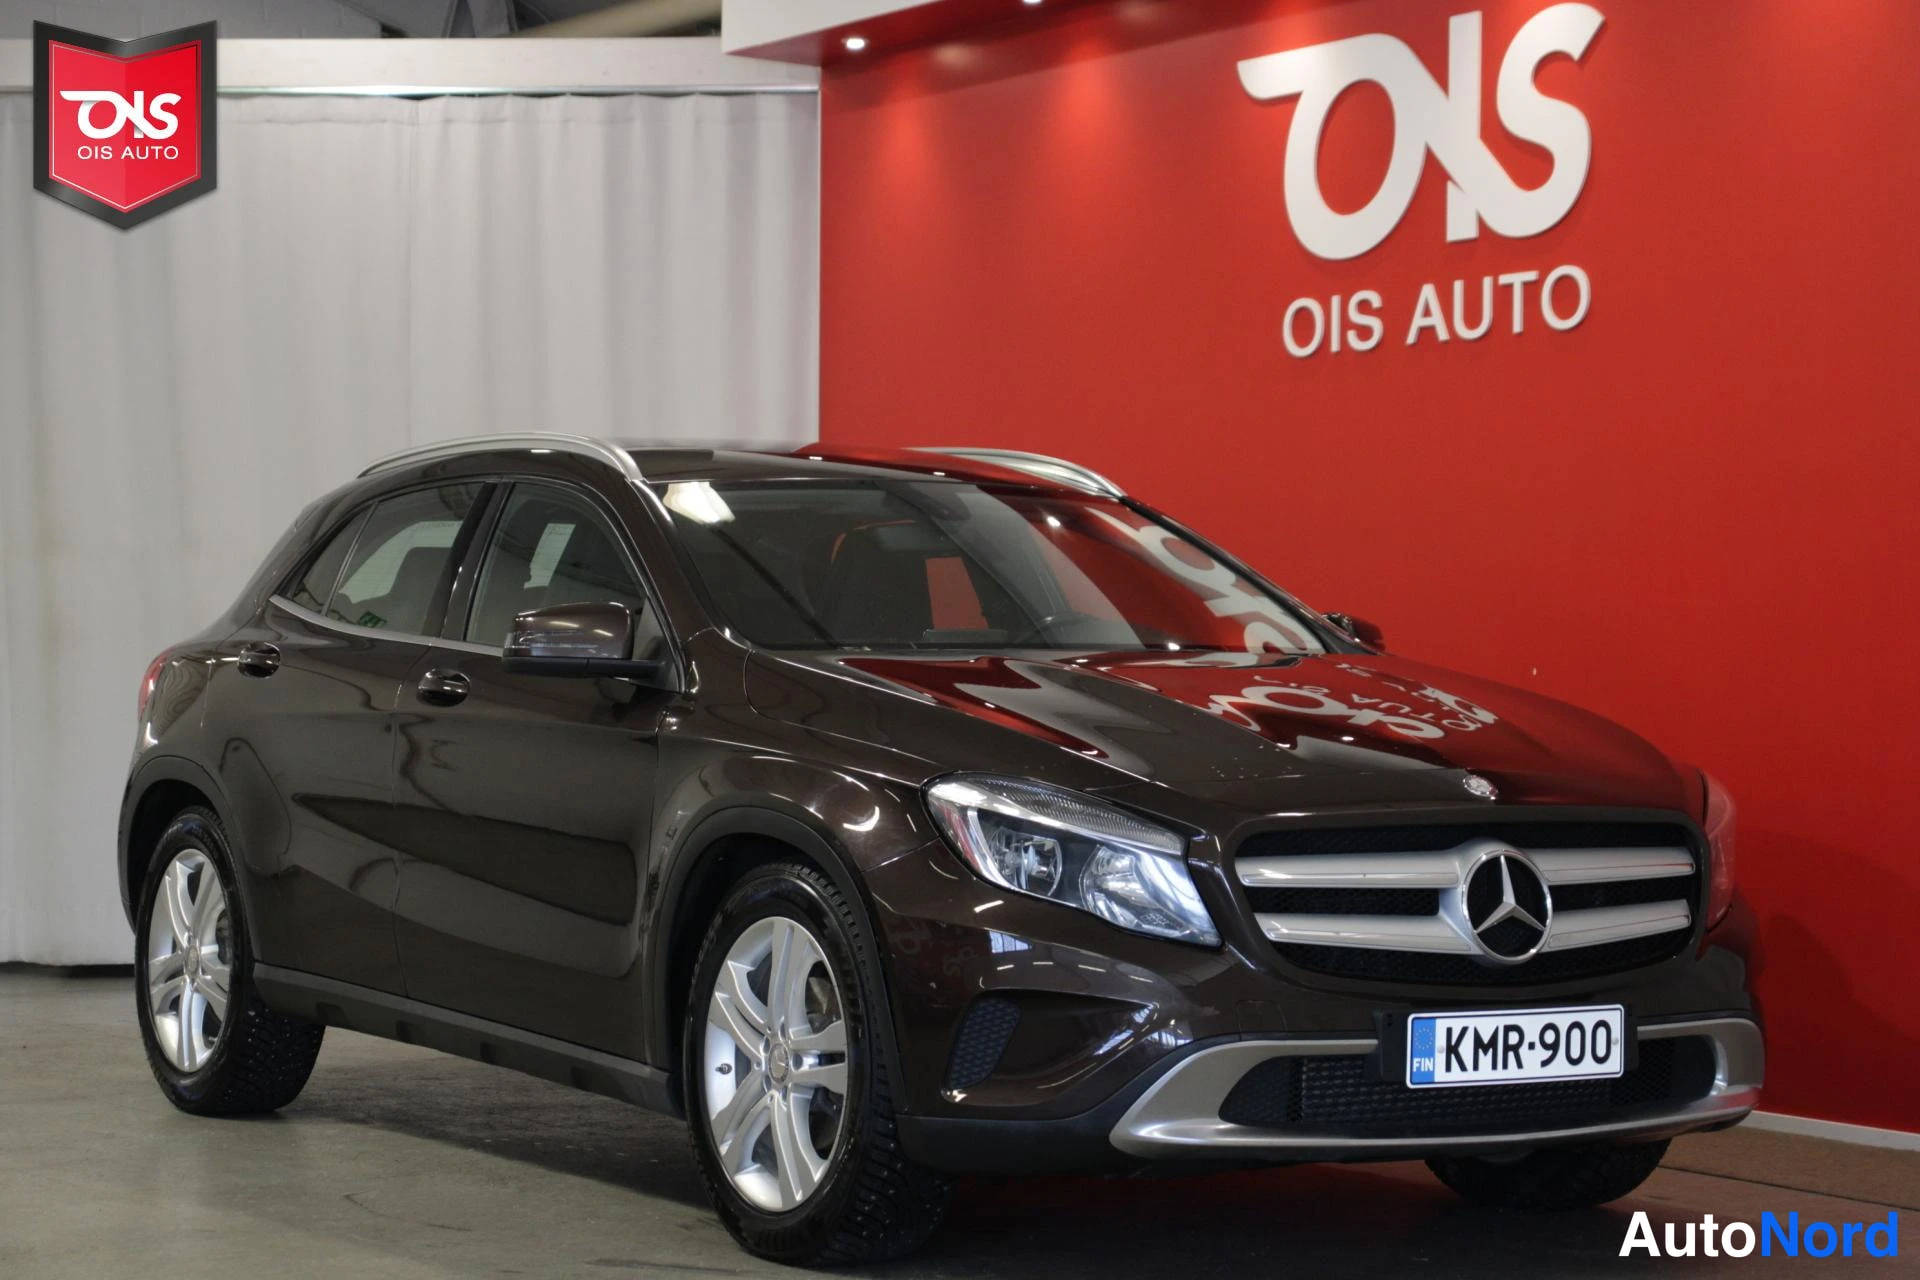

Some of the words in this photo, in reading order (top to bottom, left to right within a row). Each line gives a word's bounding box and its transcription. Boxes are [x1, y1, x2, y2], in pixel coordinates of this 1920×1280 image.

[1282, 289, 1384, 358] OIS
[1405, 264, 1592, 345] AUTO
[1412, 1057, 1434, 1073] FIN
[1444, 1019, 1612, 1074] KMR-900
